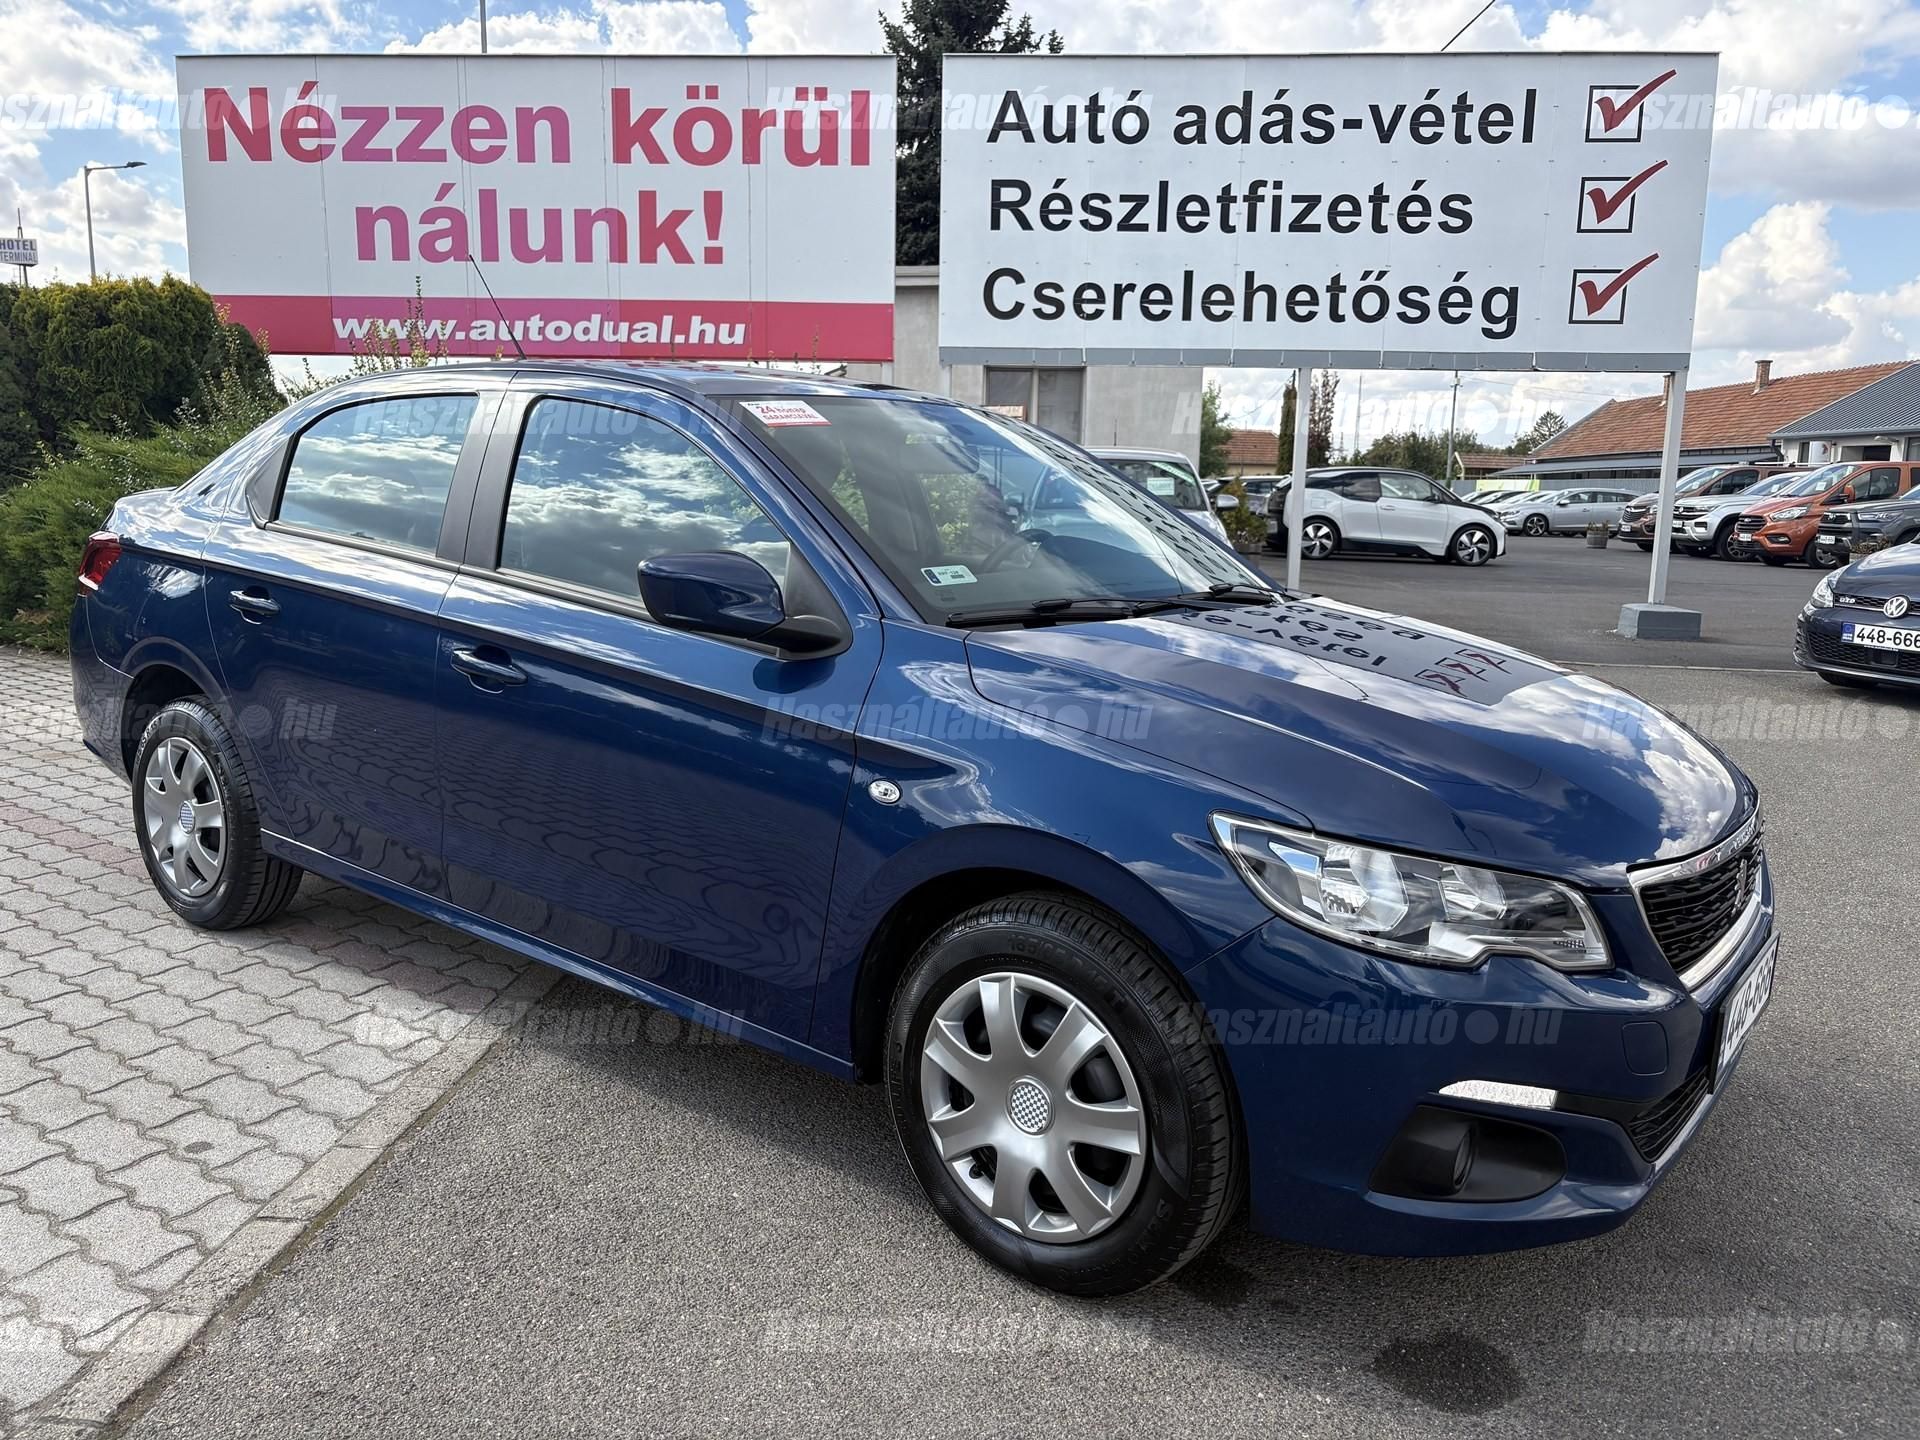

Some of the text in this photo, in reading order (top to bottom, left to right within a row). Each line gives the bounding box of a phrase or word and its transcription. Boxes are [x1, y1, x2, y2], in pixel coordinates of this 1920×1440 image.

[203, 81, 871, 167] Nézzen körül
[986, 88, 1537, 146] Autó adás-vétel
[356, 183, 724, 265] nálunk!
[990, 179, 1474, 235] Részletfizetés
[0, 239, 37, 251] HOTEL
[332, 314, 746, 345] www.autodual.hu
[983, 268, 1519, 340] Cserelehetőség
